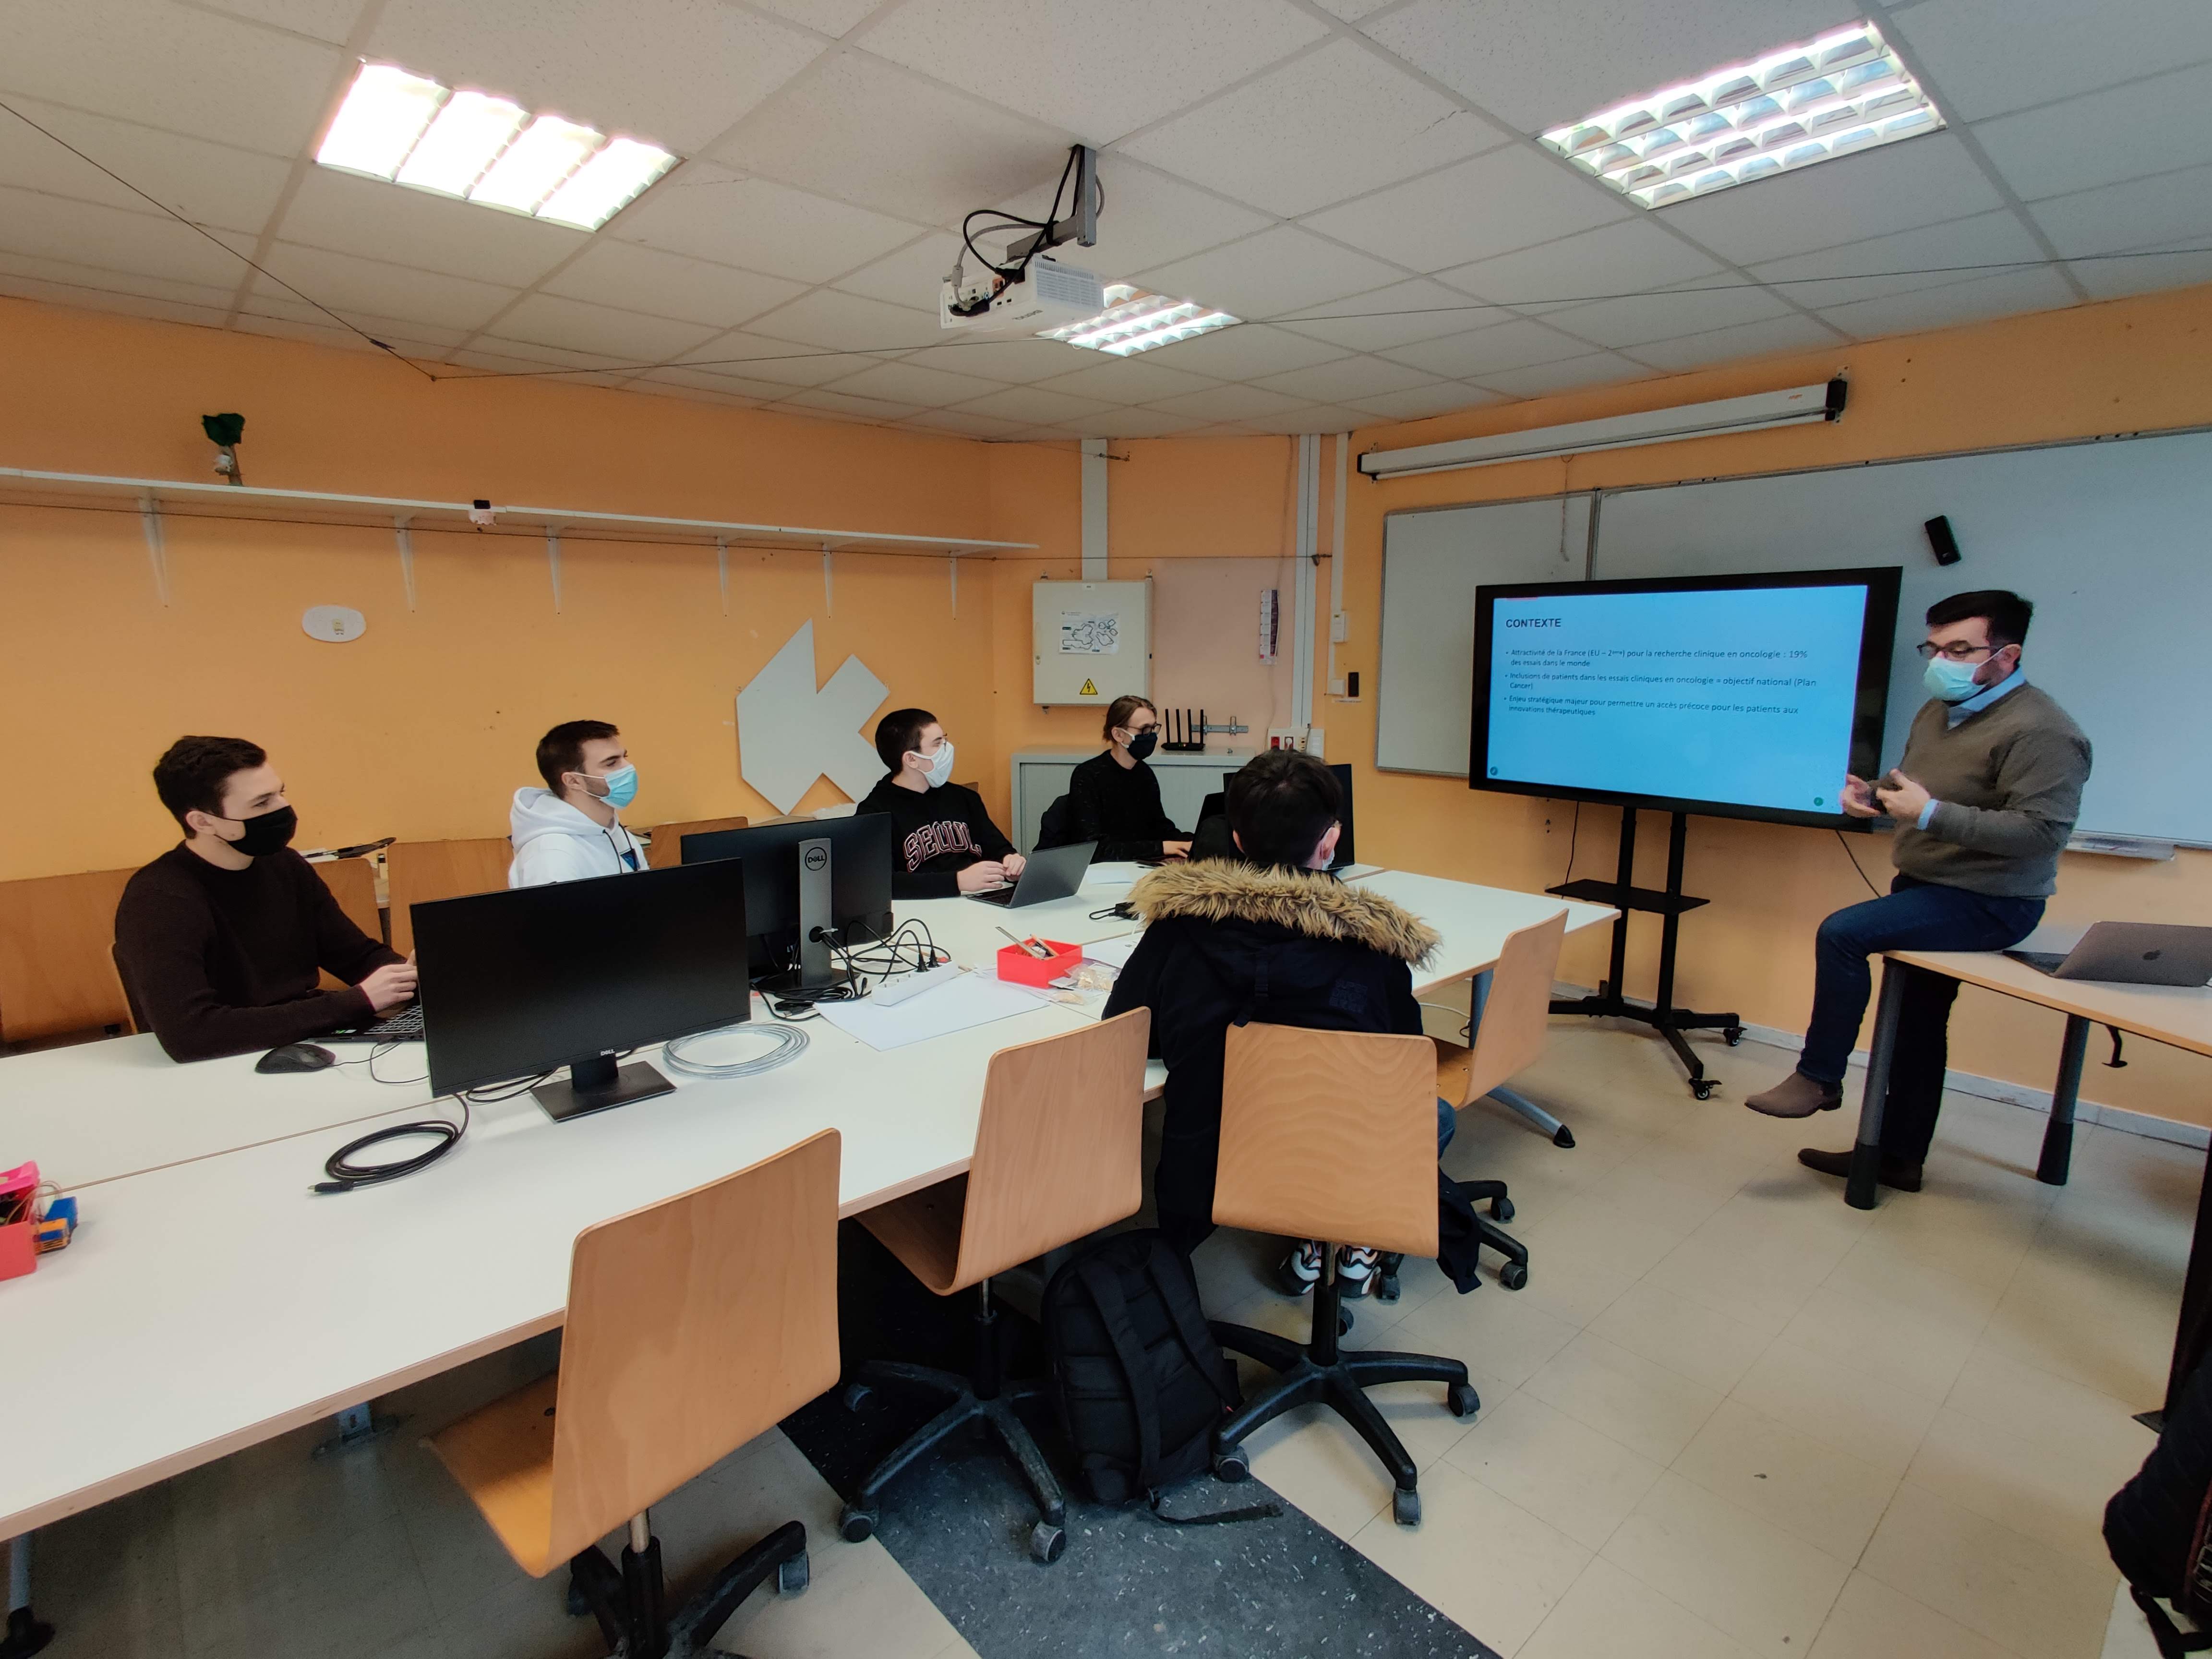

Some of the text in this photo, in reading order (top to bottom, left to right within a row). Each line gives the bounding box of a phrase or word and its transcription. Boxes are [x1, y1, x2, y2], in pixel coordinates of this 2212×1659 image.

[1506, 618, 1562, 628] CONTEXTE
[1694, 650, 1724, 659] clinique
[1740, 650, 1780, 659] oncologie
[1676, 677, 1713, 685] oncologie
[1723, 678, 1755, 686] objectif
[1794, 678, 1816, 687] (Plan
[1546, 707, 1595, 715] thérapeutiques
[1679, 702, 1709, 710] précoce
[1746, 705, 1780, 713] patients
